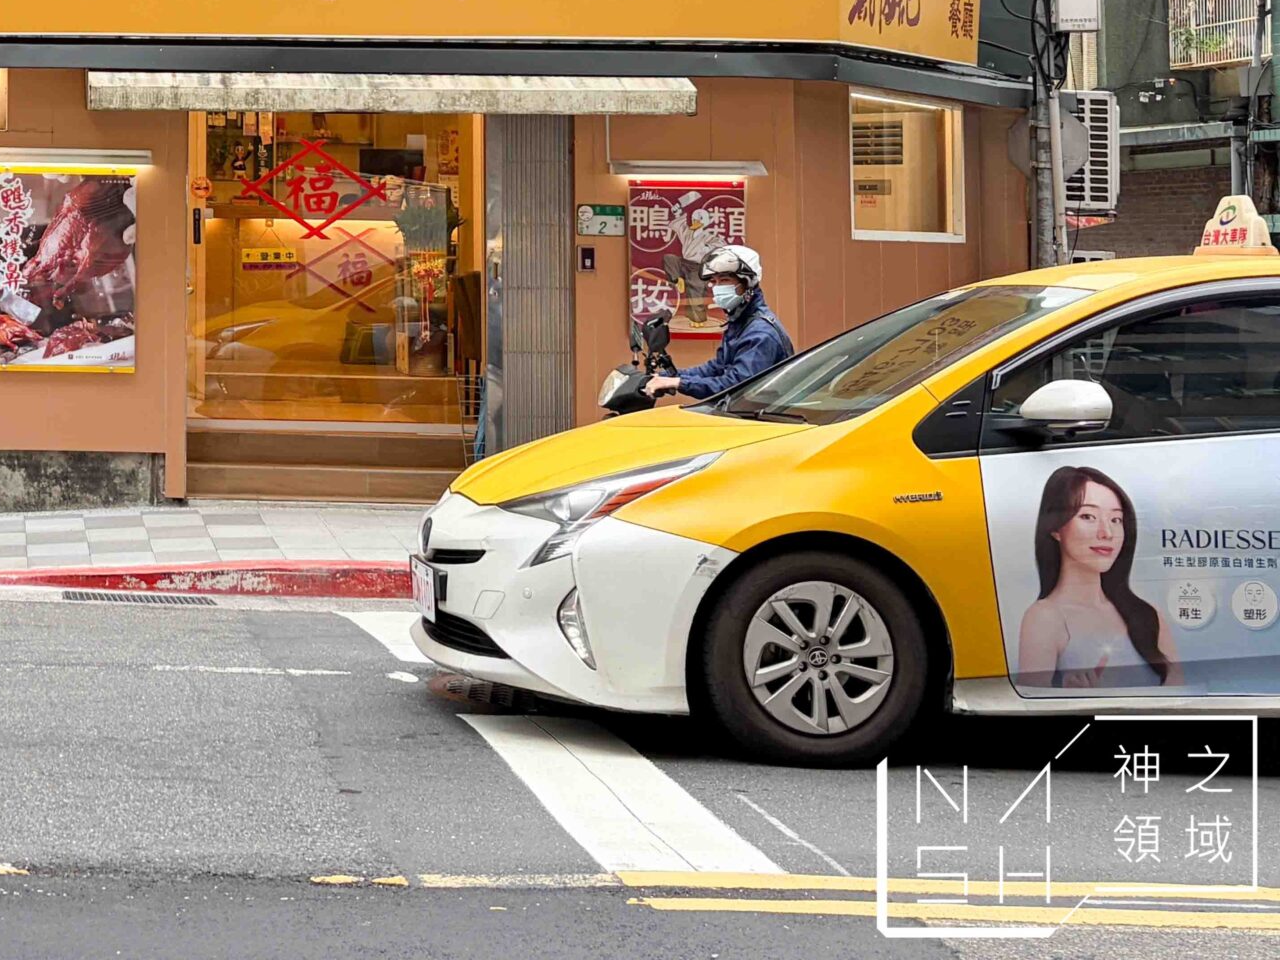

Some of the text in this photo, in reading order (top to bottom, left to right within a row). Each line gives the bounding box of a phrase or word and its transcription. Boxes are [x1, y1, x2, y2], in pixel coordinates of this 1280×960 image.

[286, 164, 339, 214] 福
[598, 221, 608, 234] 2
[629, 204, 673, 242] 鴨
[1203, 227, 1248, 246] 台灣大車隊
[1161, 529, 1280, 550] RADIESSE
[1179, 608, 1267, 621] 再生 塑形
